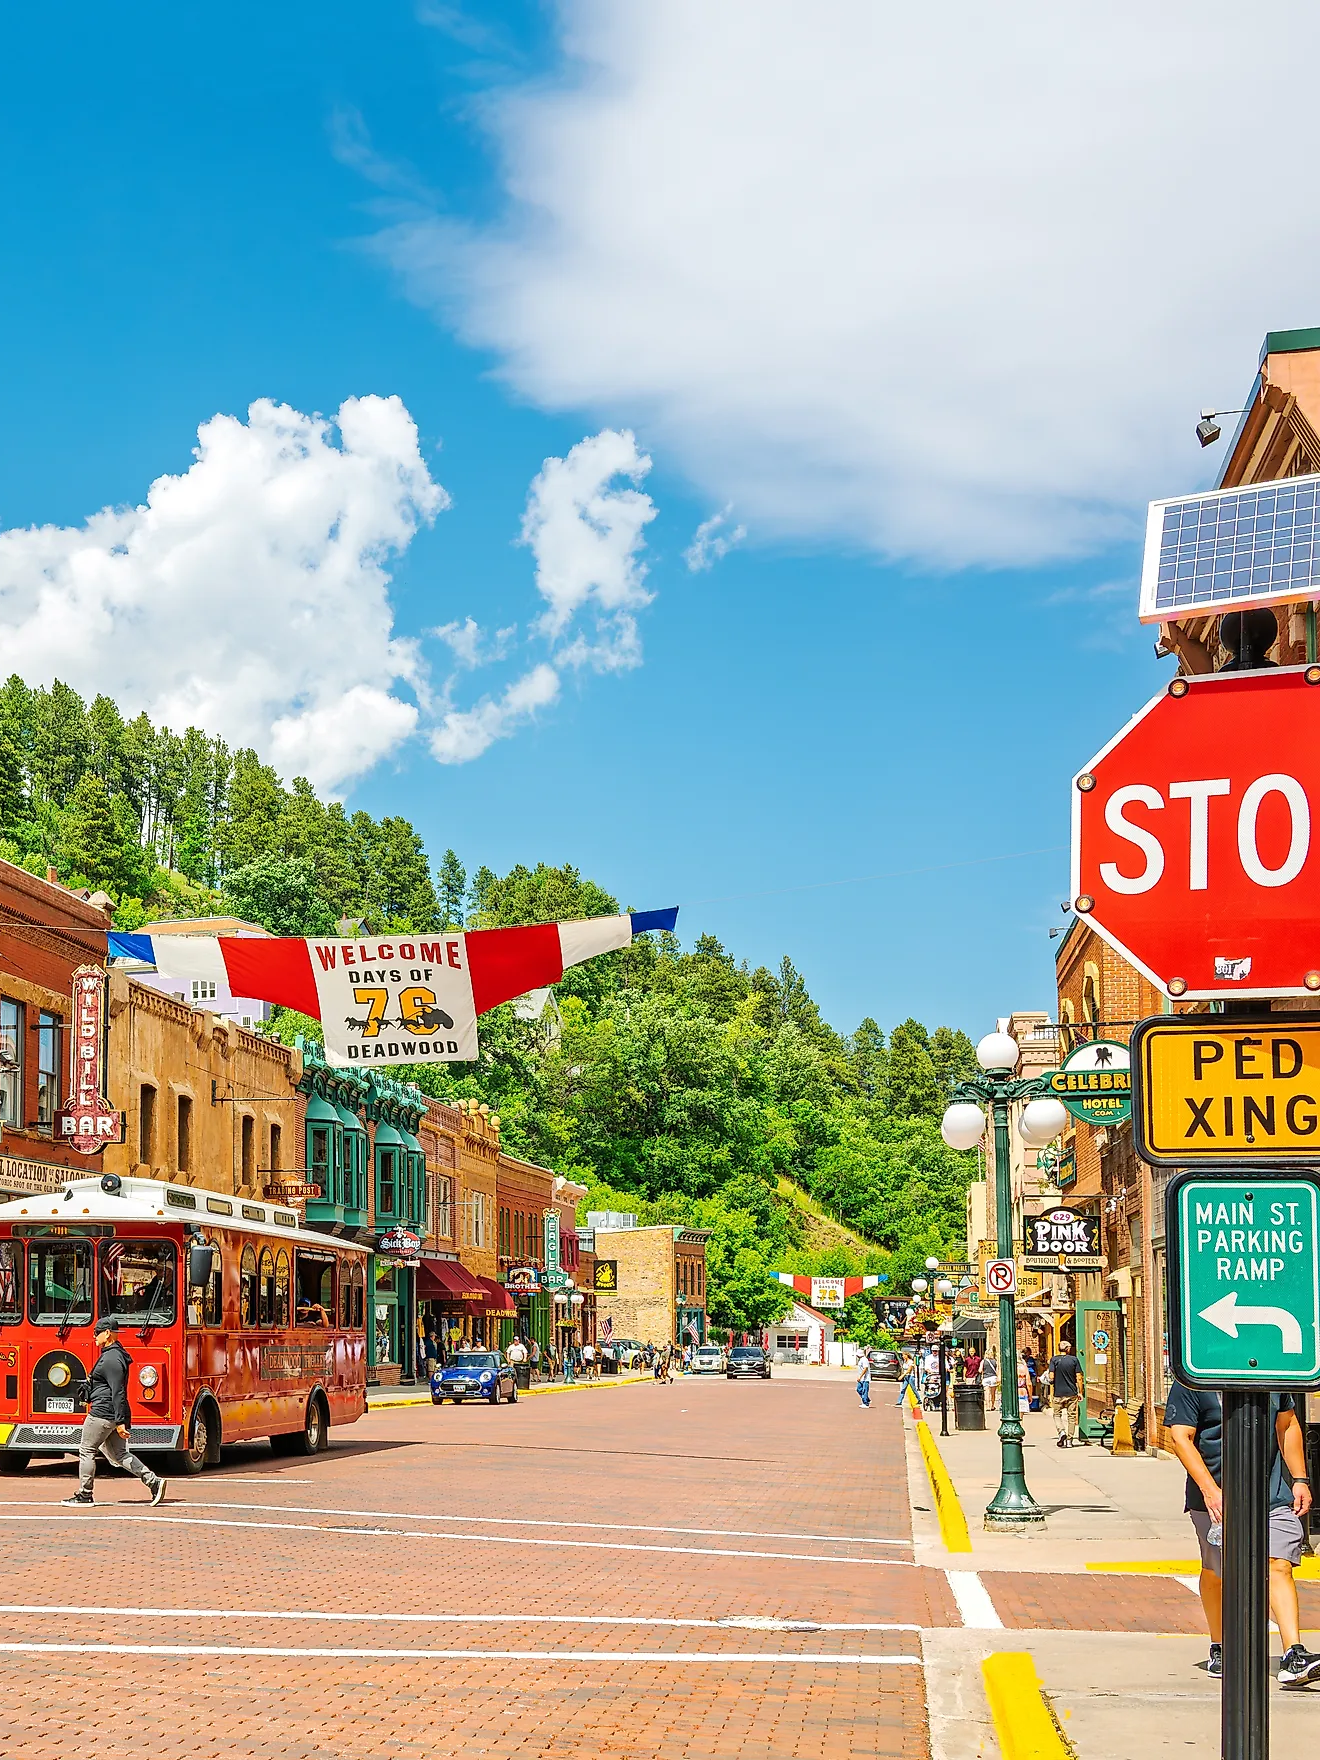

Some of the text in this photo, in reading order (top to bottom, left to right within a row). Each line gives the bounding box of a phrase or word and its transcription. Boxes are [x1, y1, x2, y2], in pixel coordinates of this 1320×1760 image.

[1099, 772, 1311, 896] STO
[314, 940, 462, 972] WELCOME
[348, 968, 433, 984] DAYS OF
[352, 986, 440, 1038] 76
[347, 1040, 458, 1059] DEADWOOD
[1193, 1038, 1303, 1081] PED
[1051, 1073, 1131, 1091] CELEBRI
[1082, 1098, 1124, 1110] HOTEL
[1184, 1094, 1319, 1138] XING
[61, 1116, 114, 1136] BAR
[6, 1160, 48, 1183] LOCATION
[268, 1186, 314, 1195] TRADING POST
[1053, 1213, 1071, 1221] 629
[1195, 1202, 1302, 1226] MAIN ST.
[1034, 1220, 1090, 1242] PINK
[548, 1222, 556, 1271] EAGLE
[1036, 1240, 1090, 1253] DOOR
[1198, 1230, 1304, 1254] PARKING
[1025, 1257, 1058, 1265] BOUTIQUE
[1216, 1257, 1285, 1281] RAMP
[504, 1282, 541, 1290] BROTHEL
[540, 1276, 564, 1284] BAR
[7, 1351, 16, 1368] 5
[269, 1354, 300, 1369] DEADWOOD
